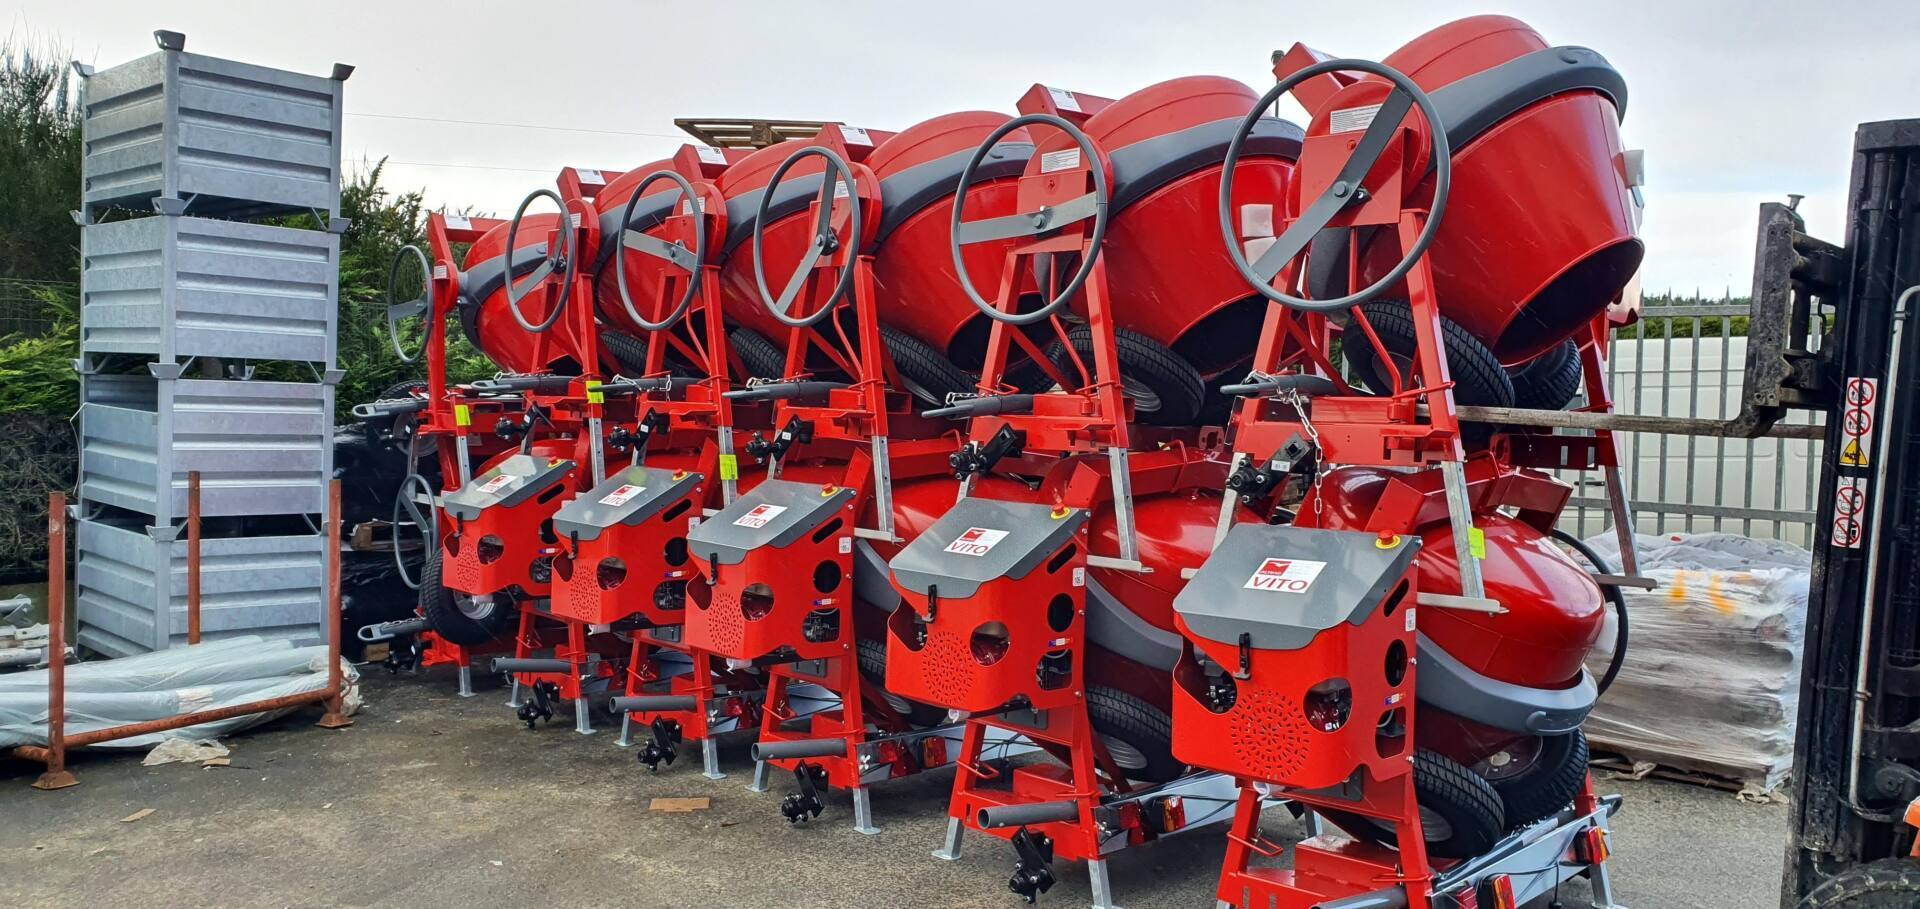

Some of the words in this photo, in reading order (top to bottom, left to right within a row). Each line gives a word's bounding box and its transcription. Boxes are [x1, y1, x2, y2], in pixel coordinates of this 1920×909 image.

[738, 516, 767, 527] VITO
[951, 542, 989, 554] VITO
[1254, 577, 1308, 590] VITO
